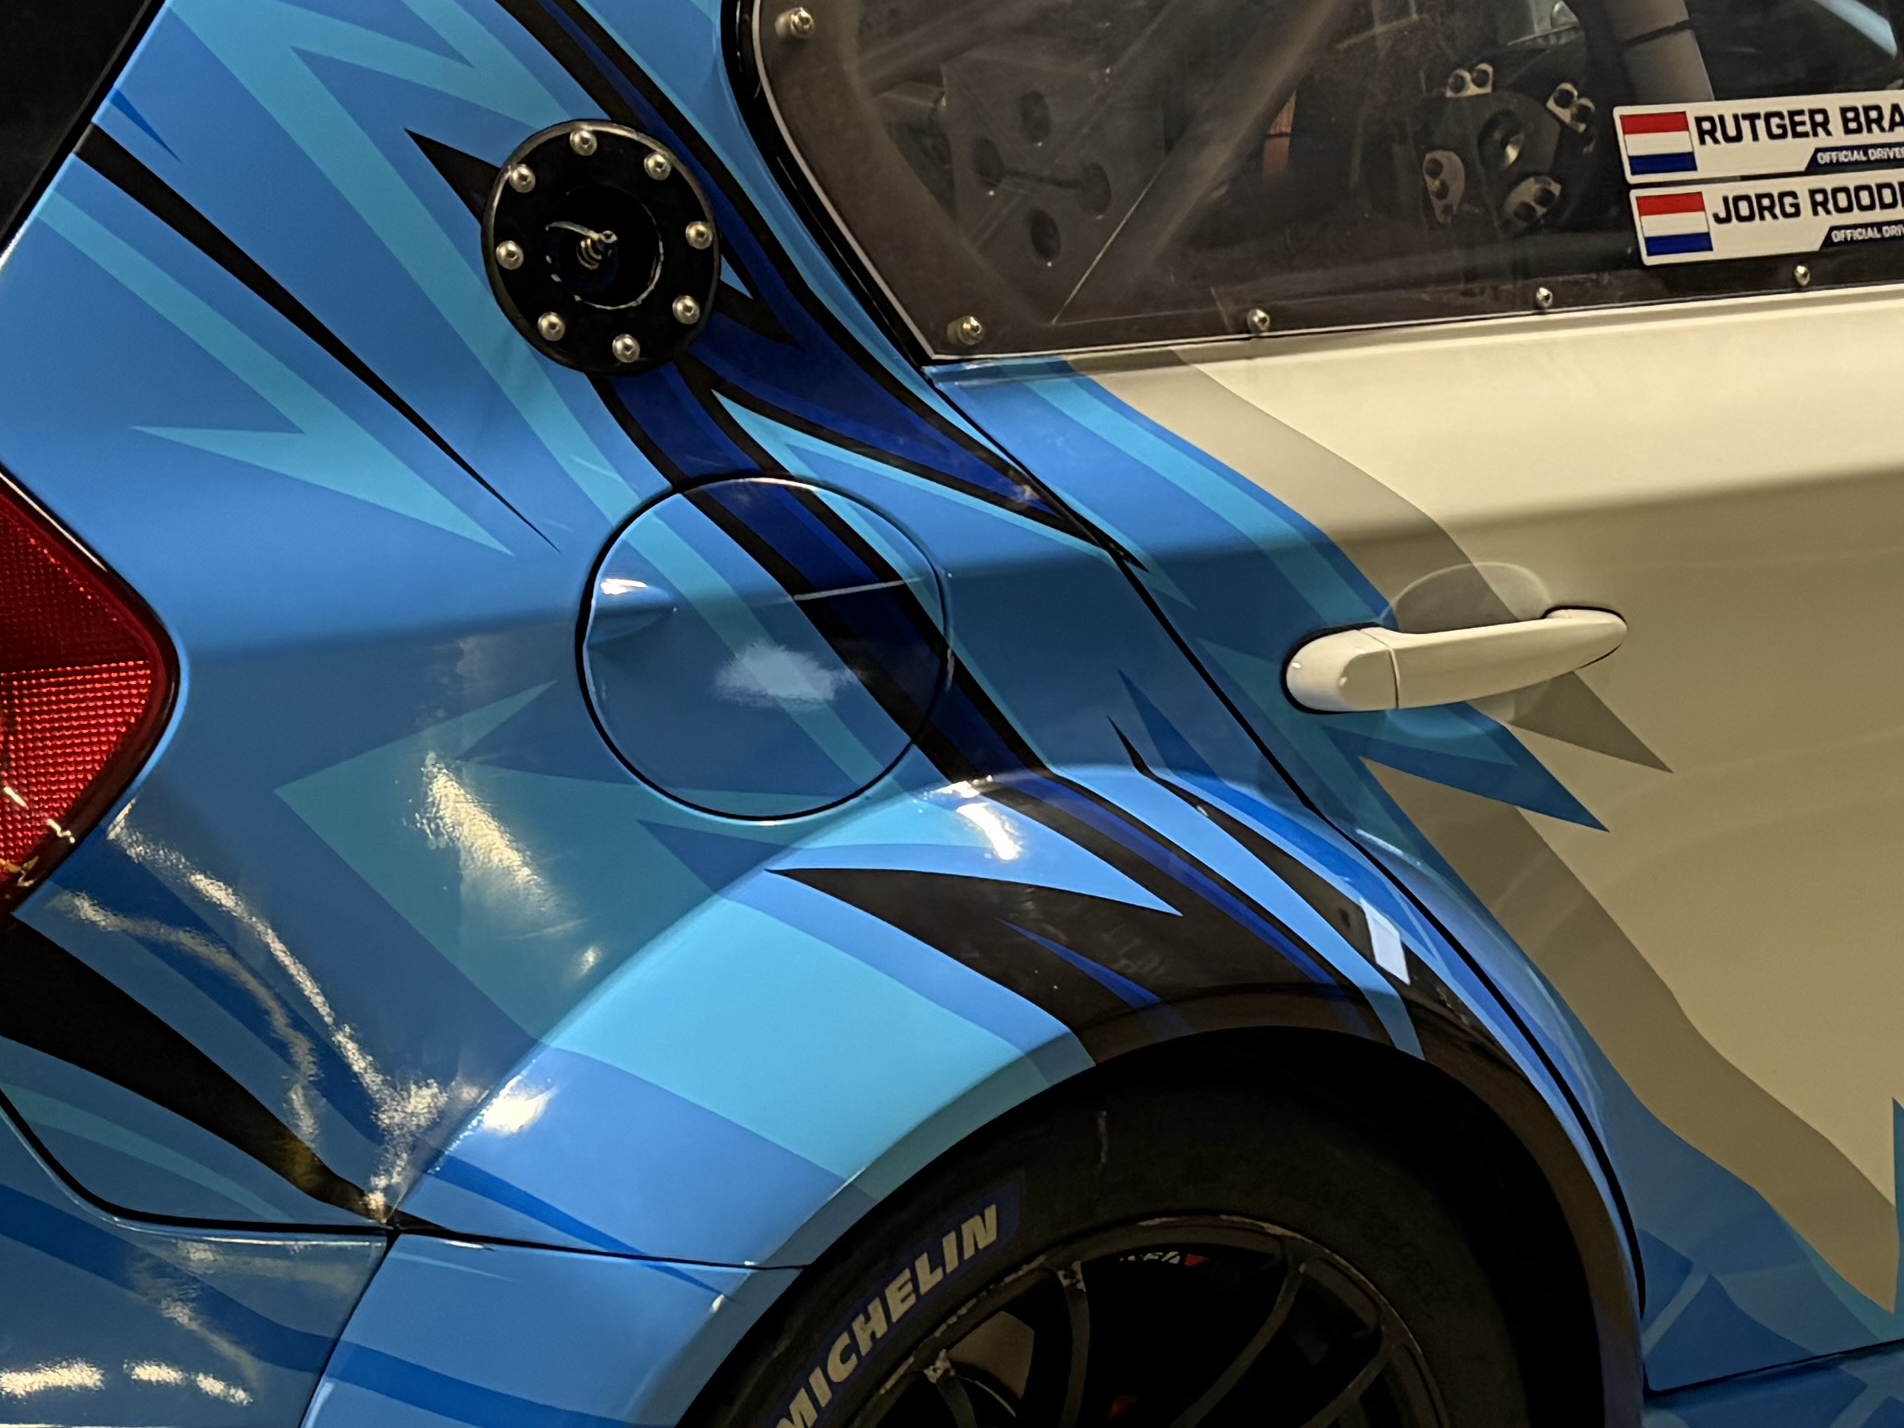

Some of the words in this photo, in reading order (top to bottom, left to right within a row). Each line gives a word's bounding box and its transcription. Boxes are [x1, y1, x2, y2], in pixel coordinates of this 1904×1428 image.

[1694, 107, 1834, 146] RUTGER
[1816, 149, 1867, 164] OFFICIAL
[1712, 191, 1801, 224] JORG
[1831, 226, 1882, 242] OFFICIAL
